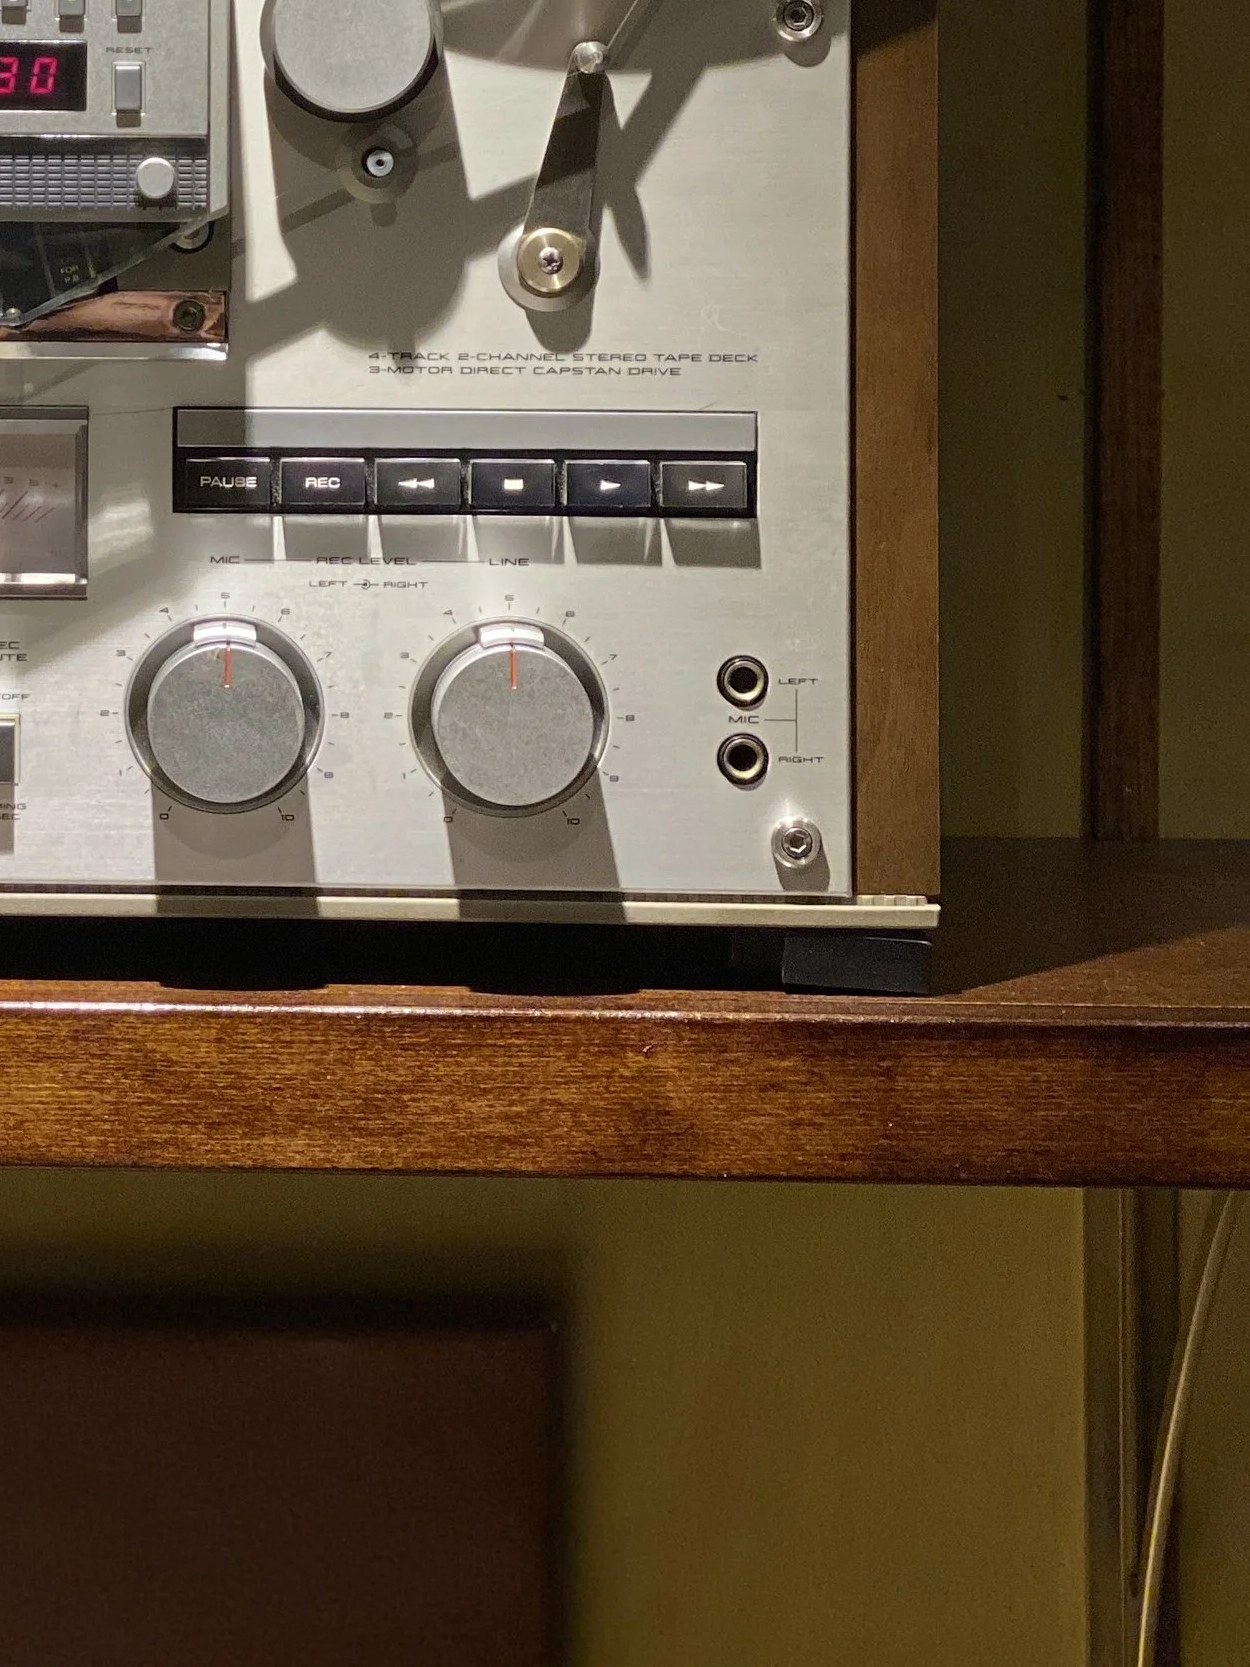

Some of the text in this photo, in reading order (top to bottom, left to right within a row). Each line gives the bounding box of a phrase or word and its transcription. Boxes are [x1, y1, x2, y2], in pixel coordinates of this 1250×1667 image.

[105, 46, 153, 55] RESET
[368, 352, 759, 363] 4-TRACK 2-CHANNEL STEREO TAPE DECK
[369, 365, 682, 376] 3-MOTOR DIRECT CAPSTAN DRIVE
[200, 476, 257, 488] PAUSE
[305, 477, 341, 489] REC
[210, 556, 530, 567] MIC REC LEVEL LINE
[309, 580, 429, 590] LEFT RIGHT
[728, 715, 759, 724] MIC
[281, 813, 295, 822] 10
